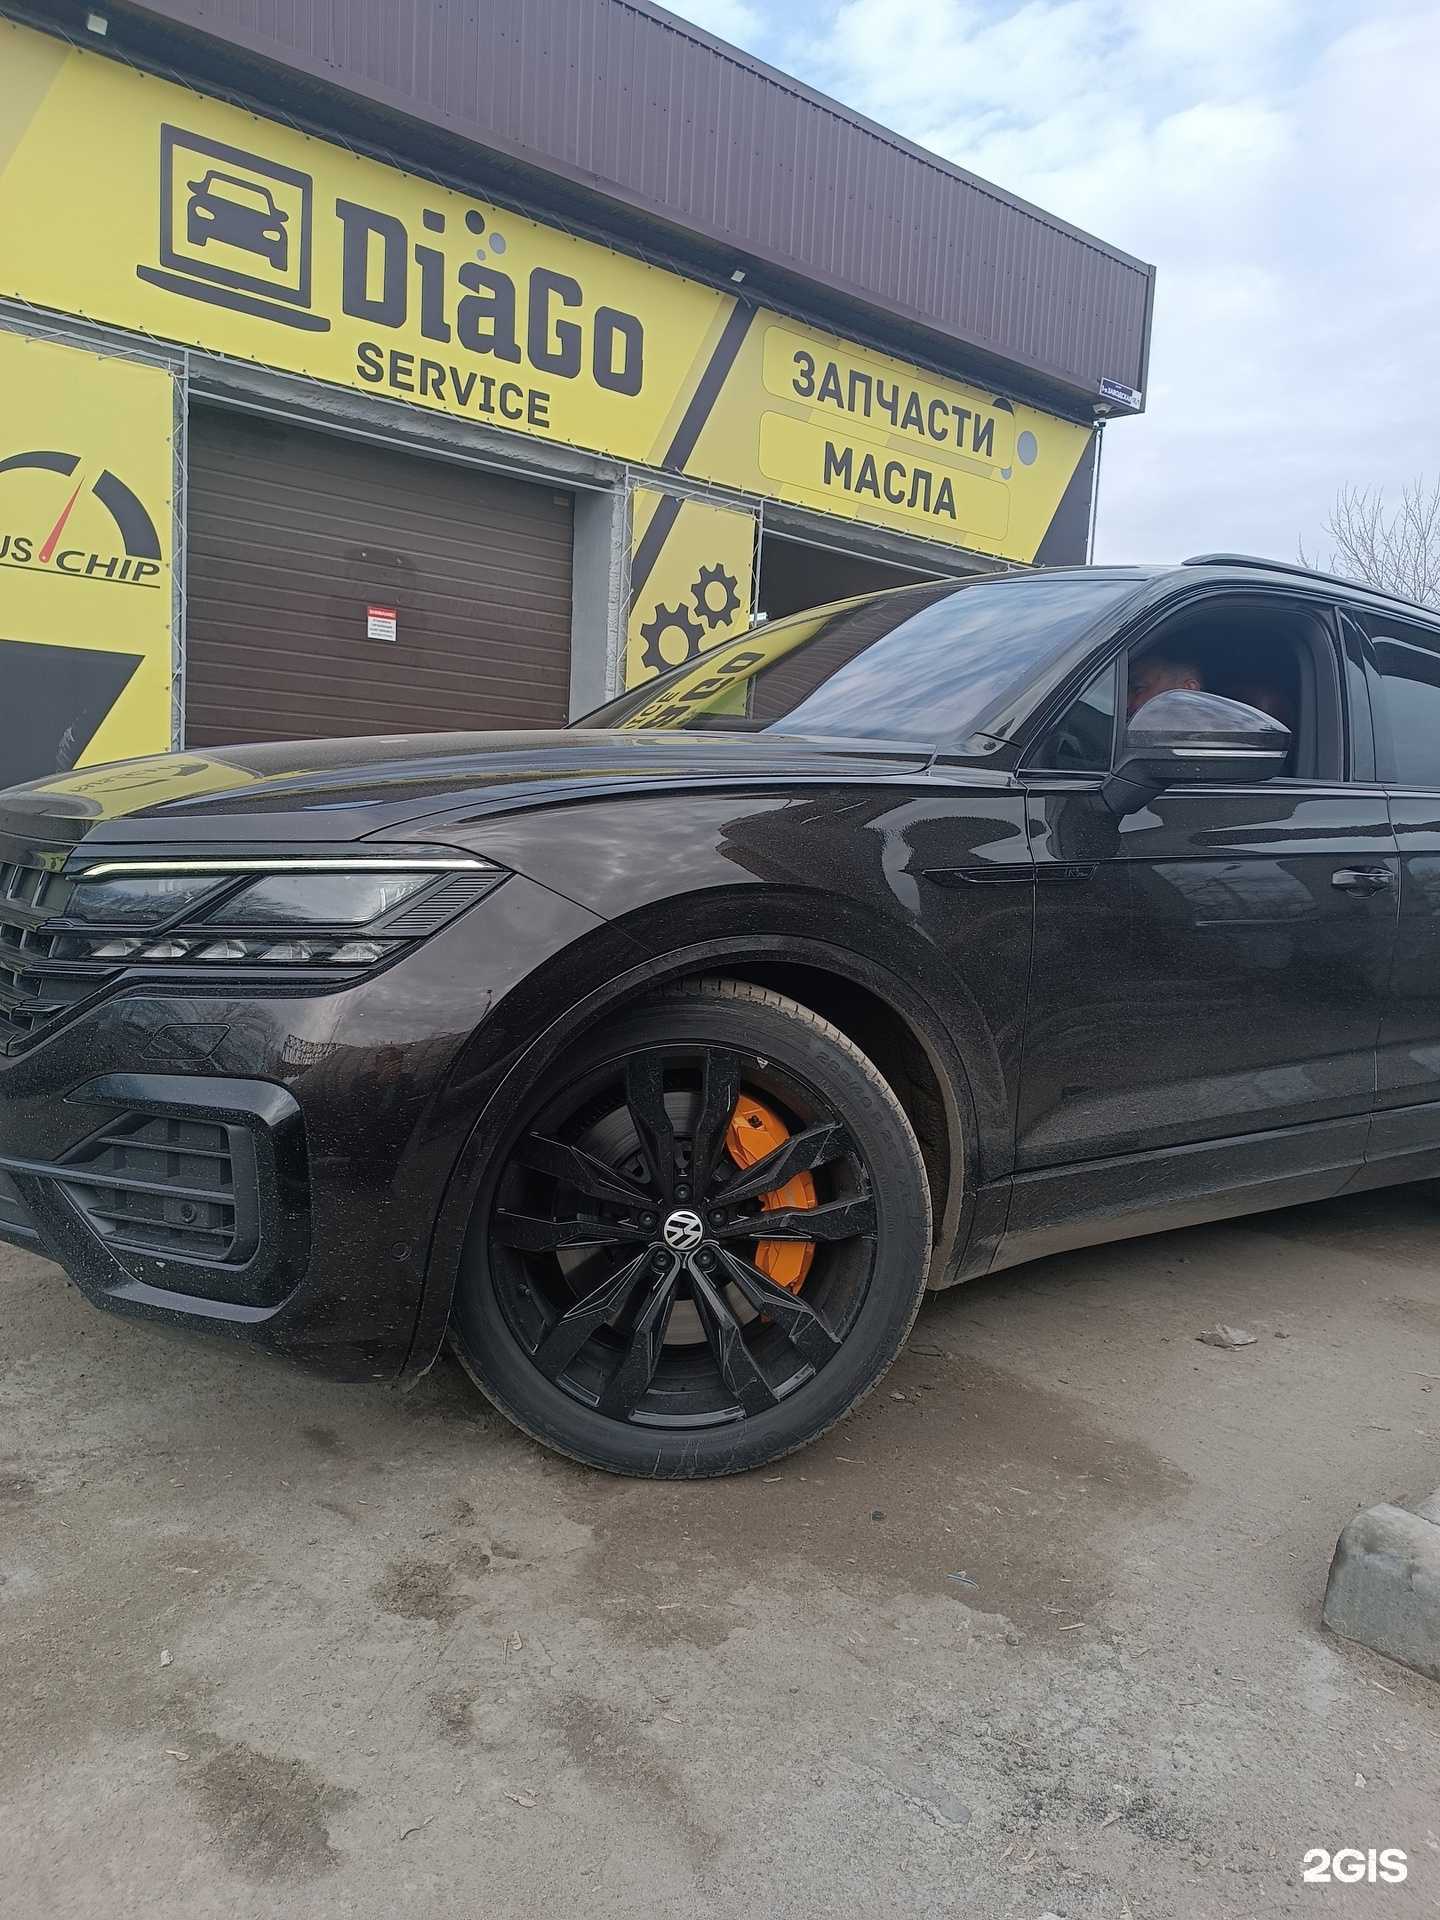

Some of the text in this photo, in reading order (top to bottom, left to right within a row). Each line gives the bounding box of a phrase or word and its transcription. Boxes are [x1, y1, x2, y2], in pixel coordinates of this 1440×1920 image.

[336, 198, 644, 397] DiaGo
[356, 341, 551, 429] SERVICE
[792, 350, 996, 458] ЗАПЧАСТИ
[824, 440, 958, 520] МАСЛА
[55, 549, 161, 582] CHIP
